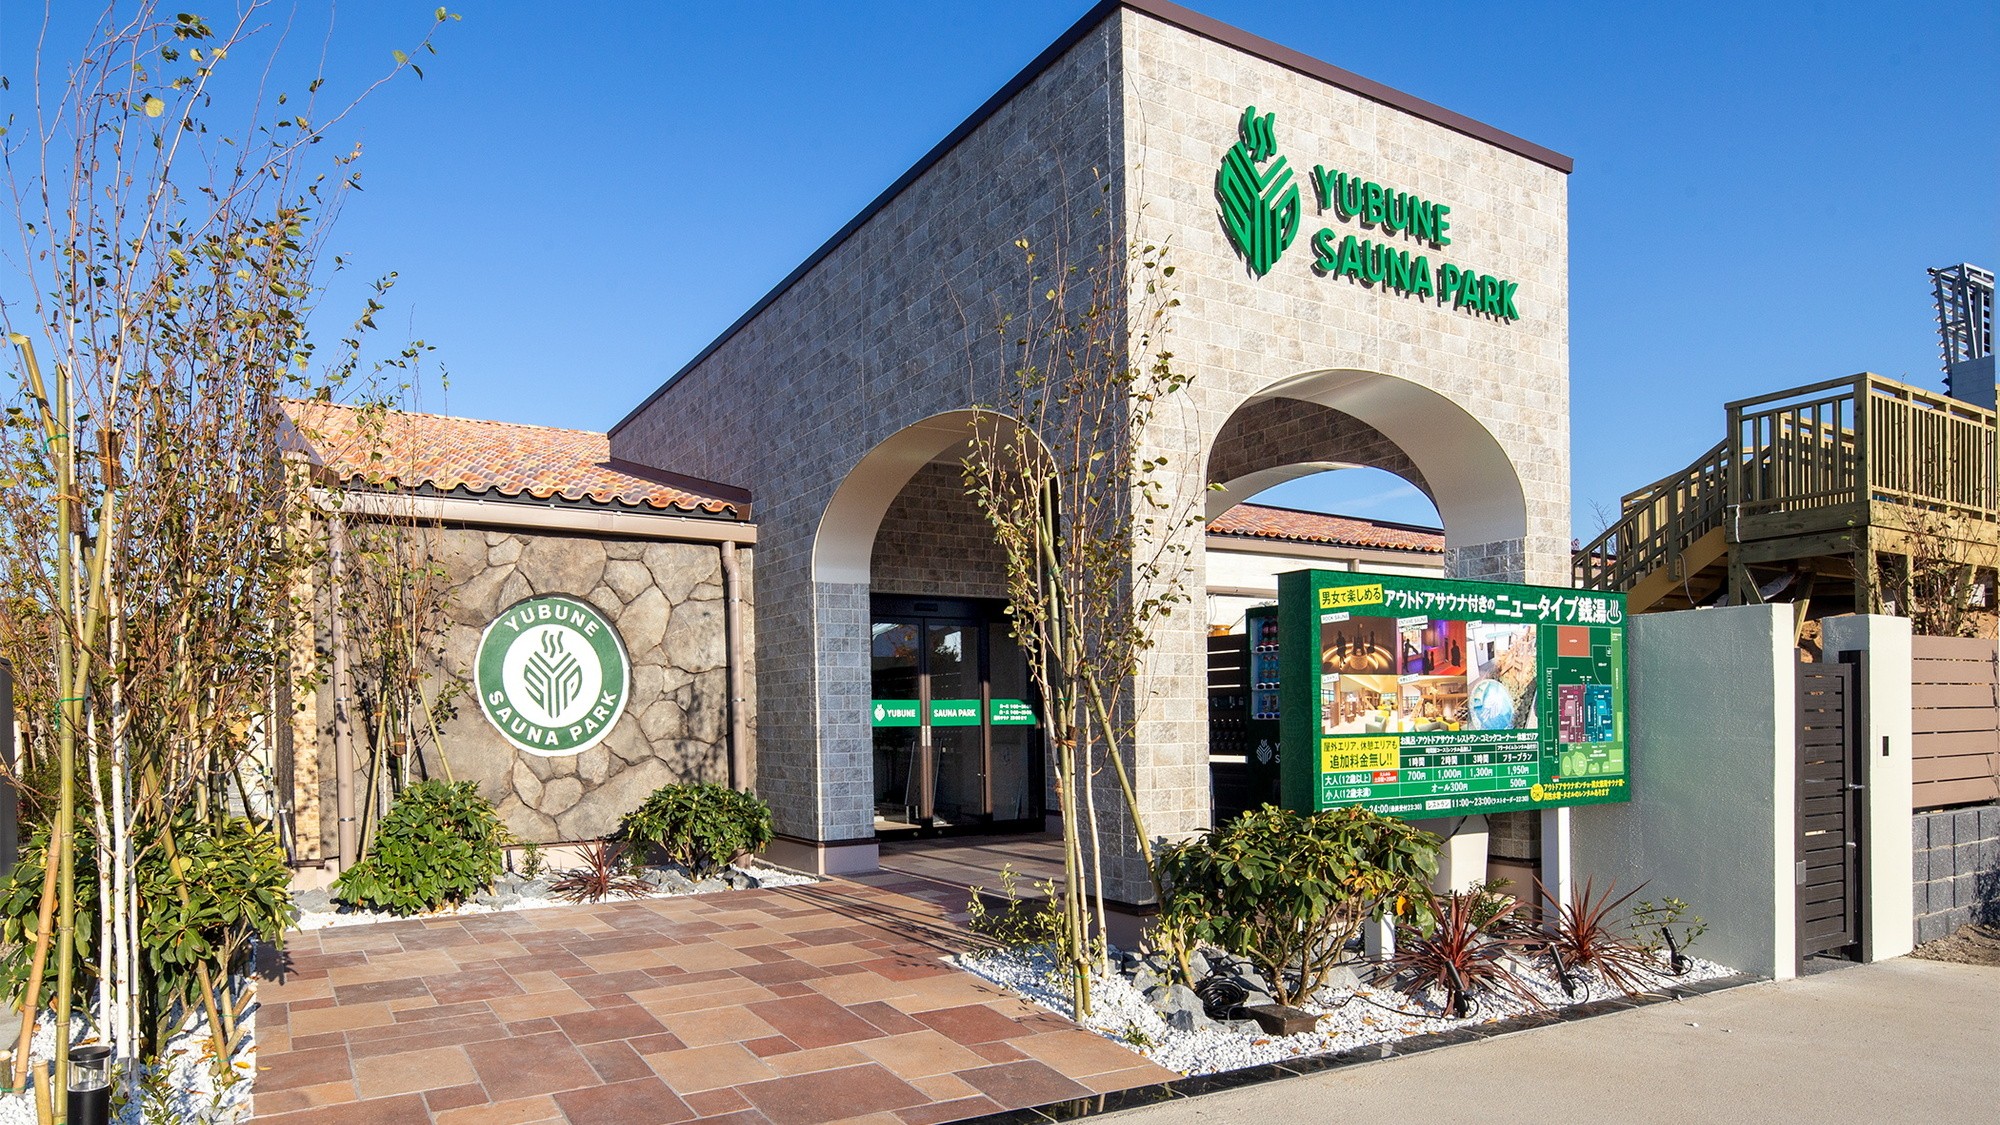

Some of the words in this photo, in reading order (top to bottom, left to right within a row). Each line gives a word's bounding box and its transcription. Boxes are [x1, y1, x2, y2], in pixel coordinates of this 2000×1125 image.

[1313, 165, 1451, 246] YUBUNE
[1314, 228, 1434, 298] SAUNA
[1440, 263, 1520, 320] PARK
[1322, 587, 1381, 605] 男女で楽しめる
[504, 604, 599, 637] YUBUNE
[489, 690, 559, 745] SAUNA
[569, 690, 617, 742] PARK
[887, 709, 916, 718] YUBUNE
[934, 709, 957, 717] SAUNA
[958, 709, 976, 717] PARK
[1408, 757, 1425, 767] 1時間
[1440, 755, 1458, 765] 2時間
[1472, 754, 1490, 764] 3時間
[1502, 752, 1533, 762] フリープラン
[1437, 769, 1462, 779] 1,000円
[1469, 767, 1493, 778] 1,300円
[1507, 765, 1529, 775] 1,950円
[1407, 771, 1426, 781] 700円
[1431, 782, 1468, 793] オール300円
[1509, 778, 1527, 788] 500円
